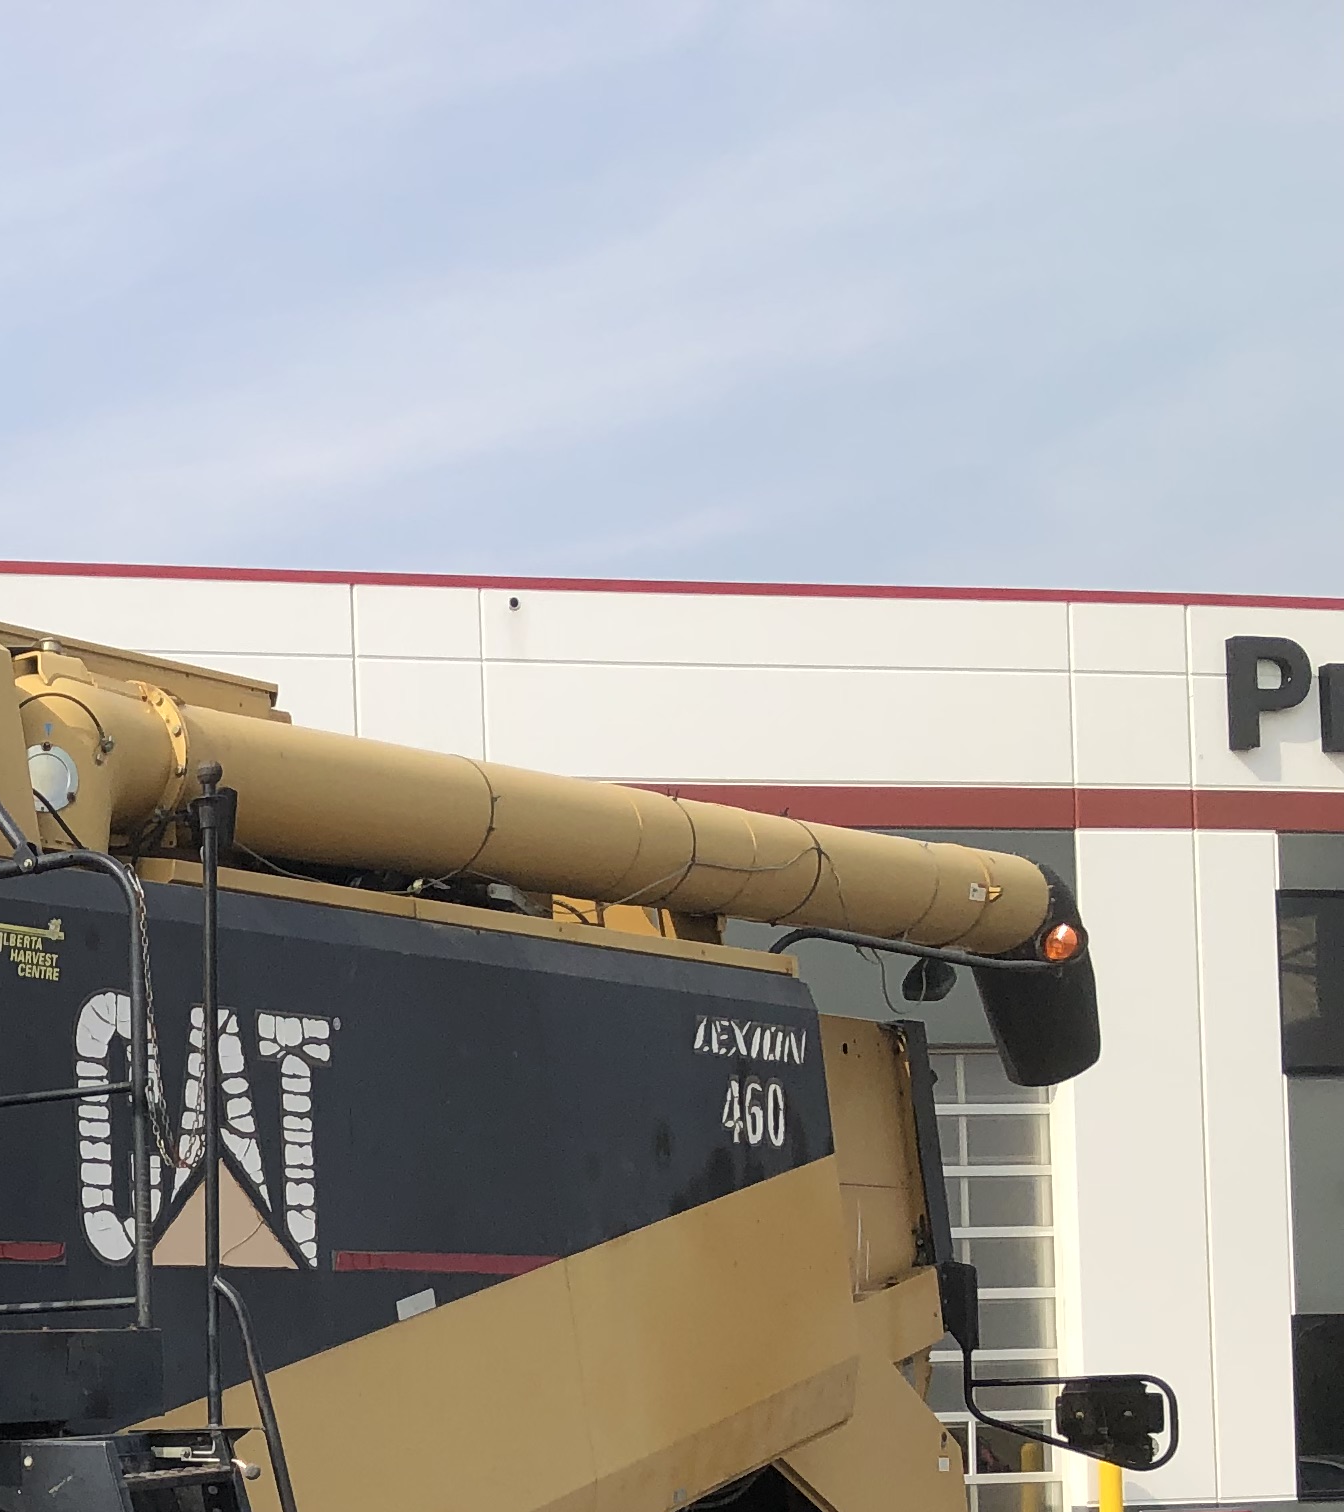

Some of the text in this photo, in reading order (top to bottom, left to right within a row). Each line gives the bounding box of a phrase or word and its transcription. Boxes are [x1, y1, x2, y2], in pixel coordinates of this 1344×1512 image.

[1224, 635, 1344, 752] P
[10, 948, 59, 967] HARVEST
[18, 963, 60, 981] CENTRE
[693, 1016, 807, 1065] LEXION
[75, 991, 331, 1269] CAT
[722, 1079, 786, 1148] 460
